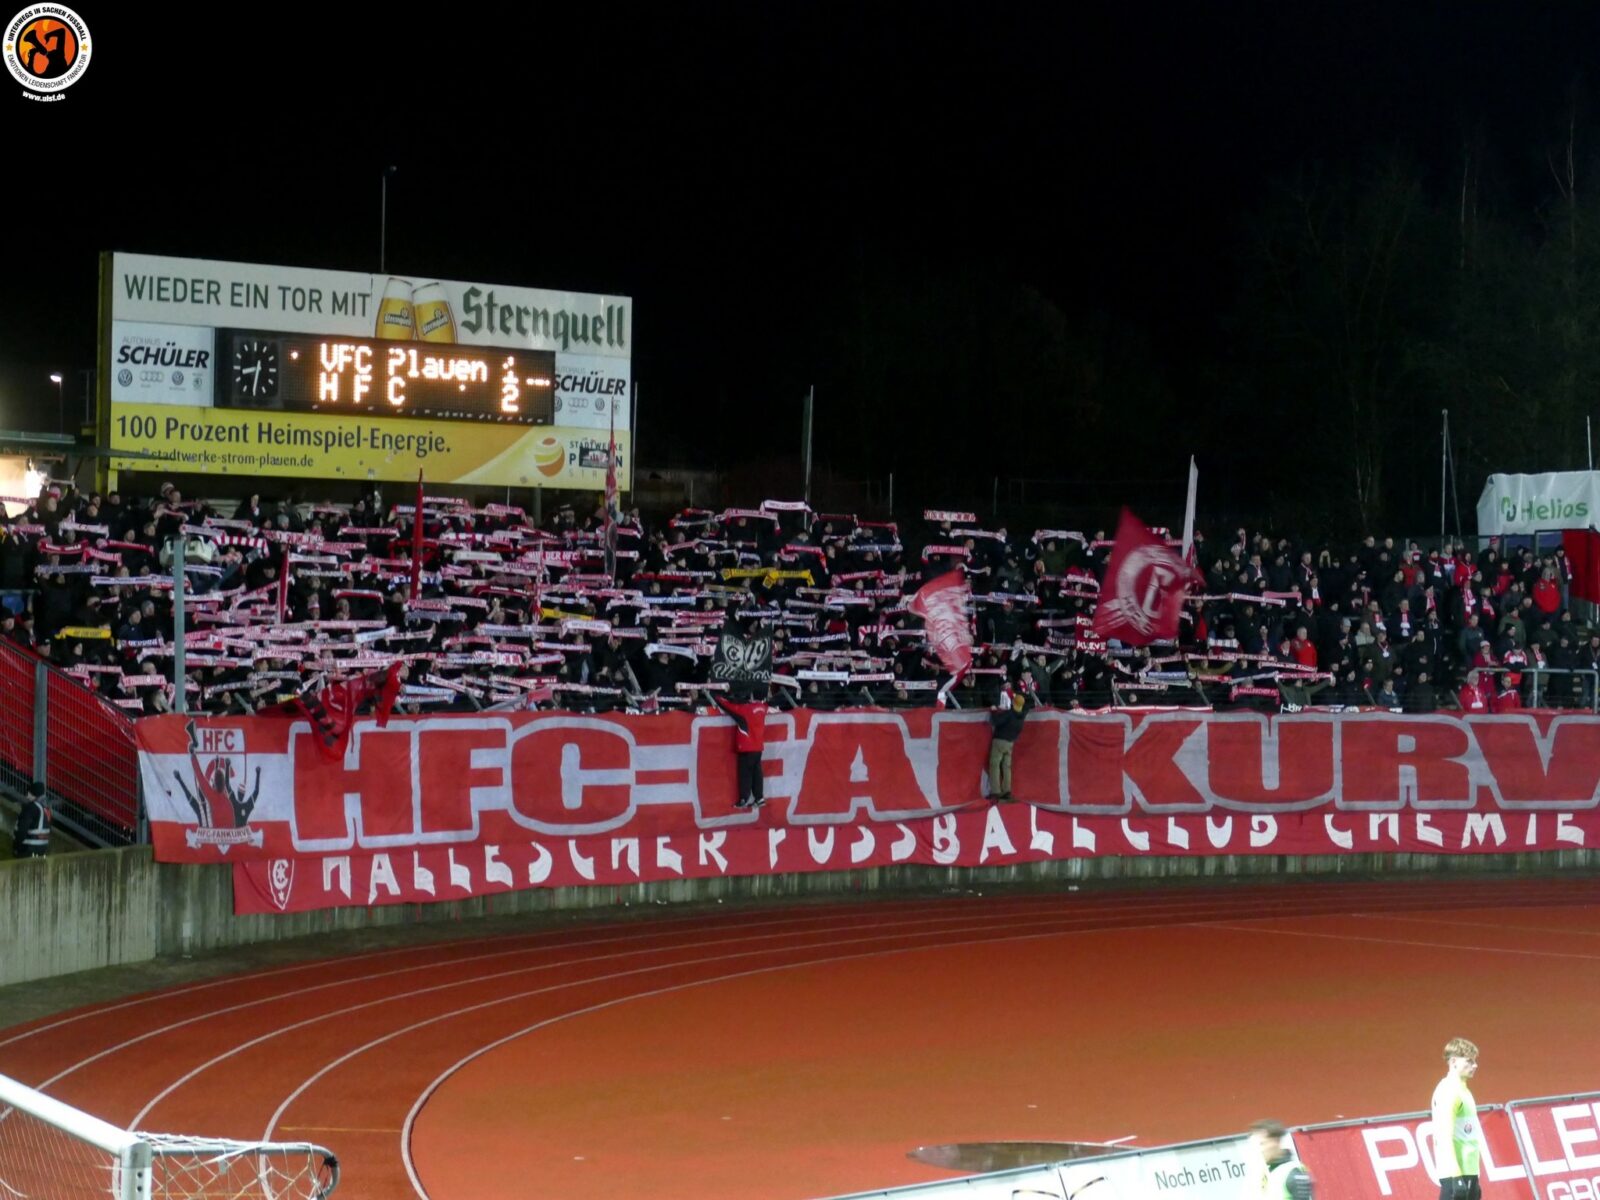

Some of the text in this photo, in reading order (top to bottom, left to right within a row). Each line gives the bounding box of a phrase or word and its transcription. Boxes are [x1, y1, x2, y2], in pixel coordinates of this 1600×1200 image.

[124, 274, 371, 317] WIEDER EIN TOR MIT
[461, 285, 625, 351] Sternquell
[117, 341, 210, 369] SCHÜLER
[320, 343, 373, 374] VFC
[502, 384, 520, 413] 2
[116, 415, 451, 458] 100 Prozent Heimspiel-Energie.
[1520, 496, 1589, 520] Helios
[545, 551, 561, 561] DER
[202, 729, 236, 752] HFC
[1324, 813, 1585, 850] CHEMIE
[1154, 1158, 1246, 1191] Noch ein Tor
